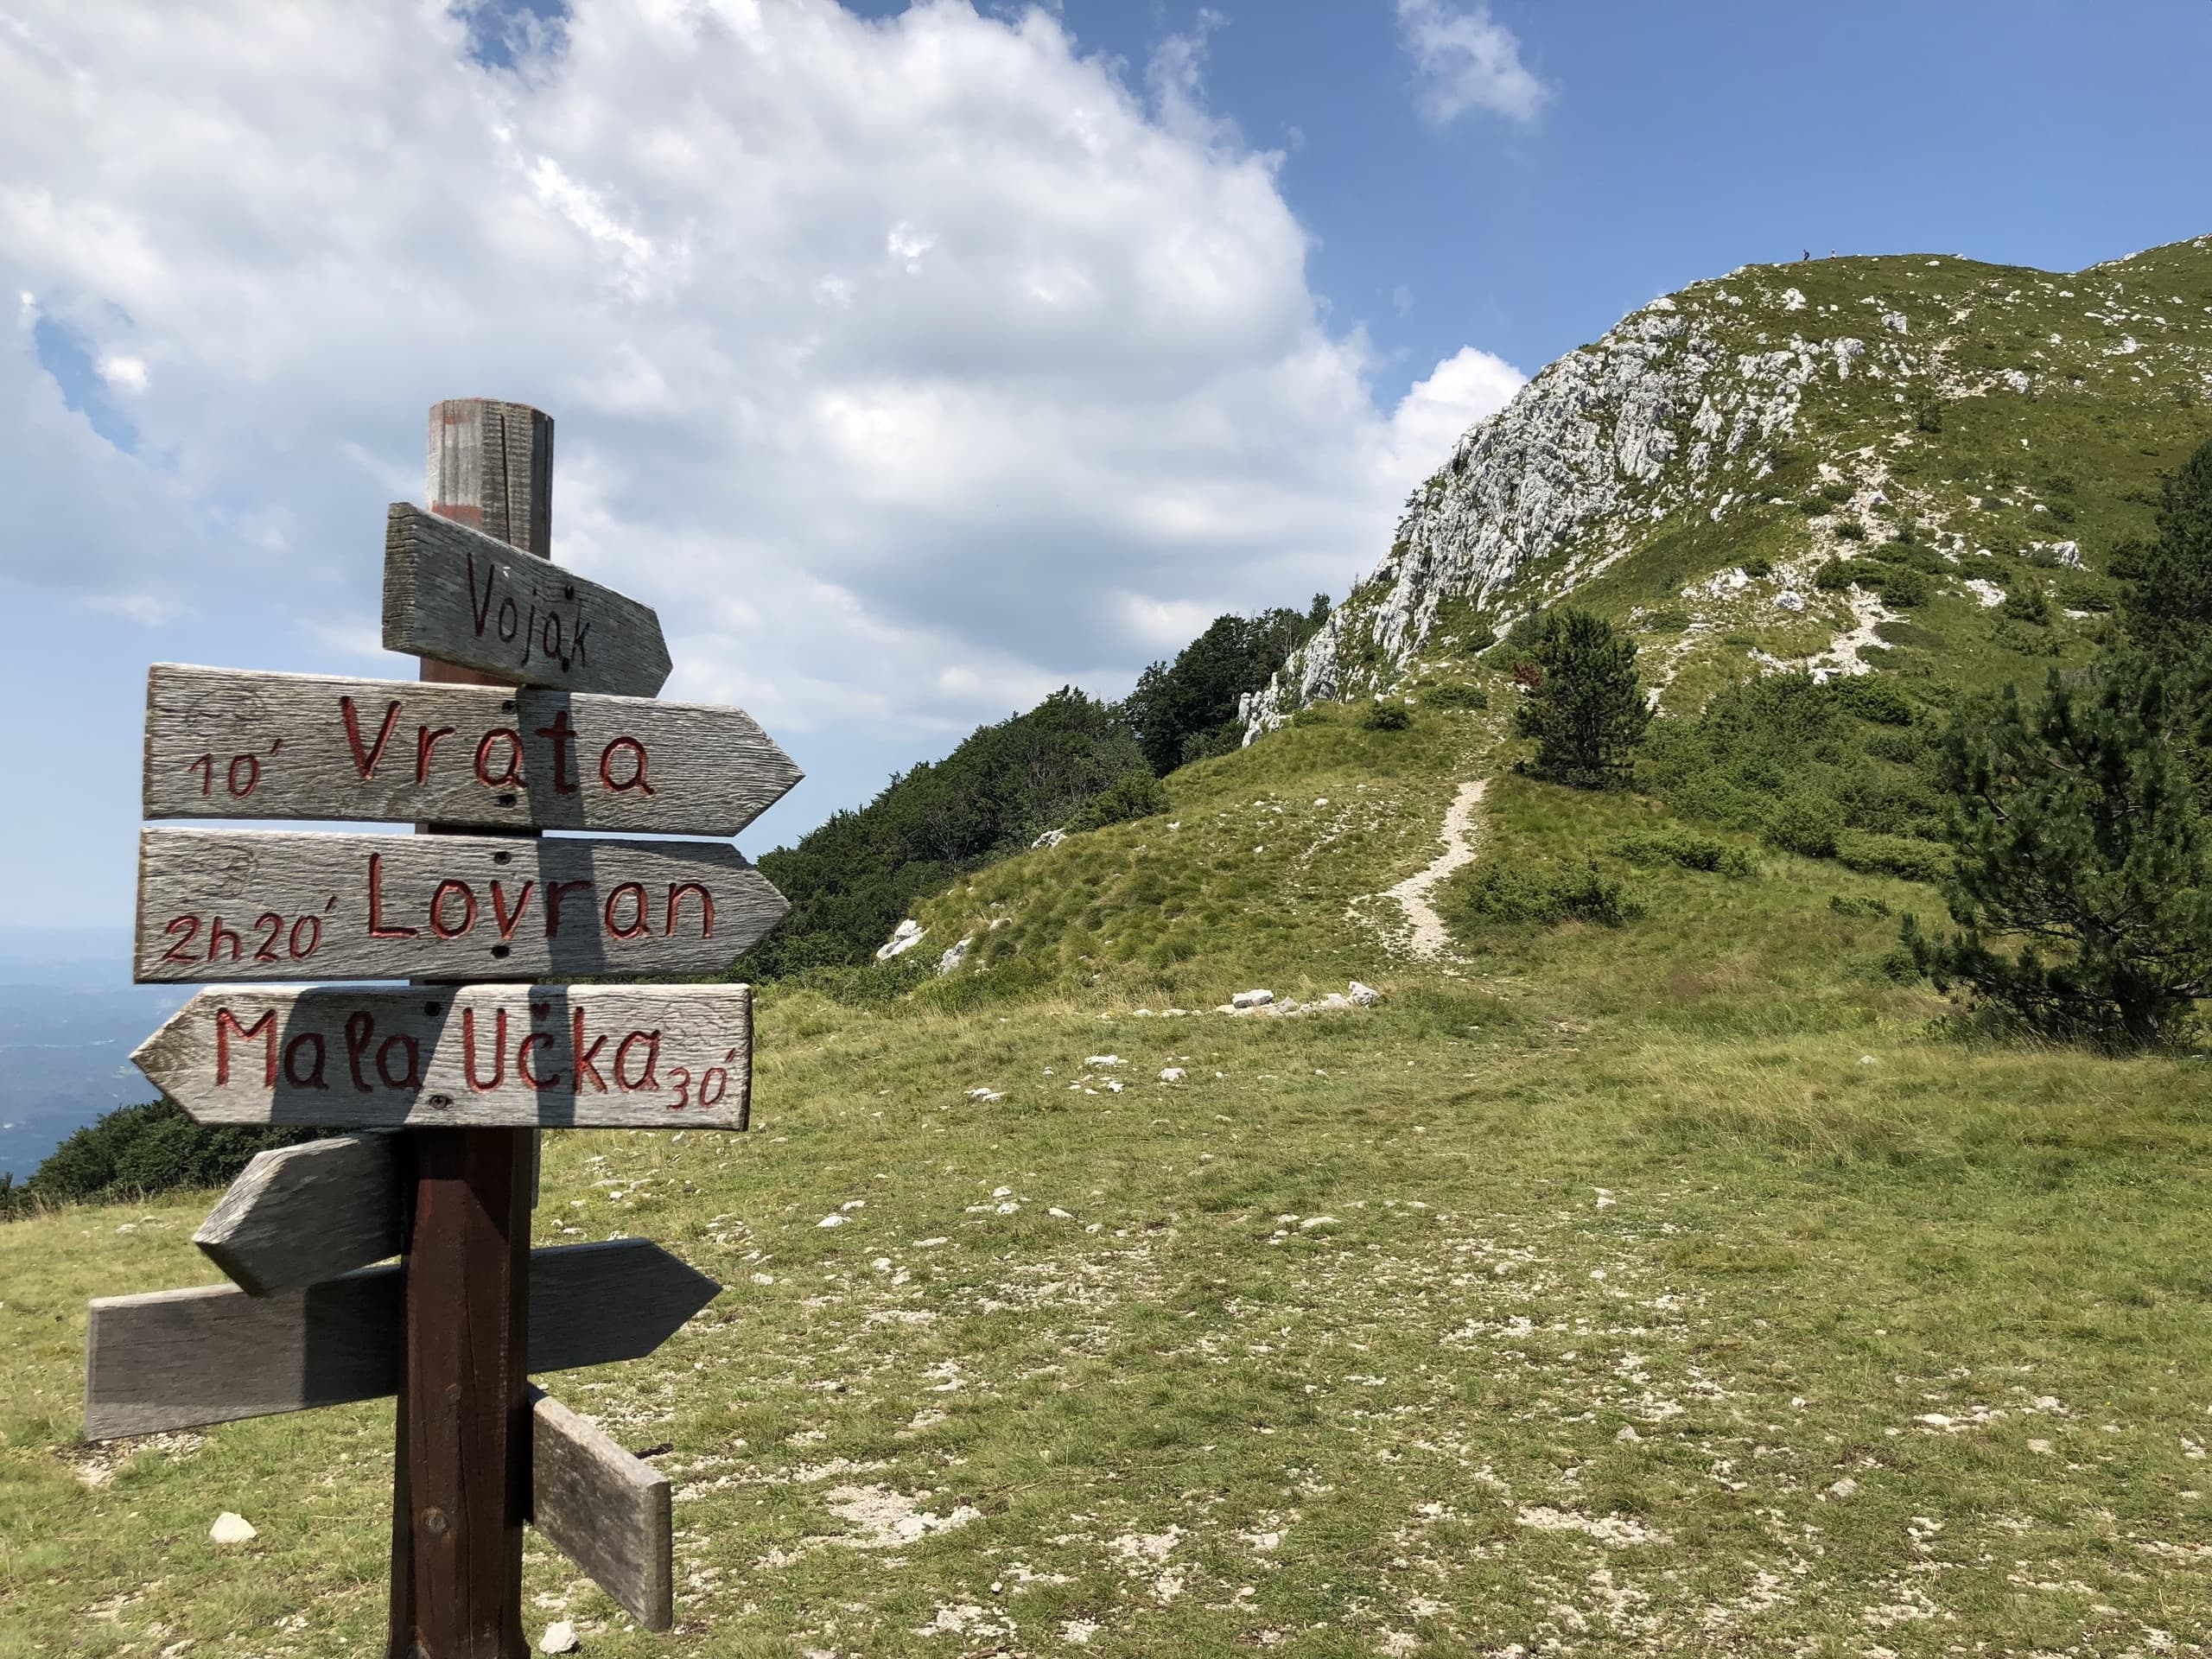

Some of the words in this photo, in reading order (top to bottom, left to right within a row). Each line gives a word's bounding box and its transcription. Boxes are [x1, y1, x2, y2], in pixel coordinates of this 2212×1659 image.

[467, 552, 591, 669] Vojak
[188, 738, 283, 800] 10'
[340, 695, 655, 797] Vrata
[369, 852, 716, 940] Lovran
[217, 1007, 423, 1094] Mala
[462, 1003, 663, 1095] Učka
[665, 1046, 737, 1110] 30'
